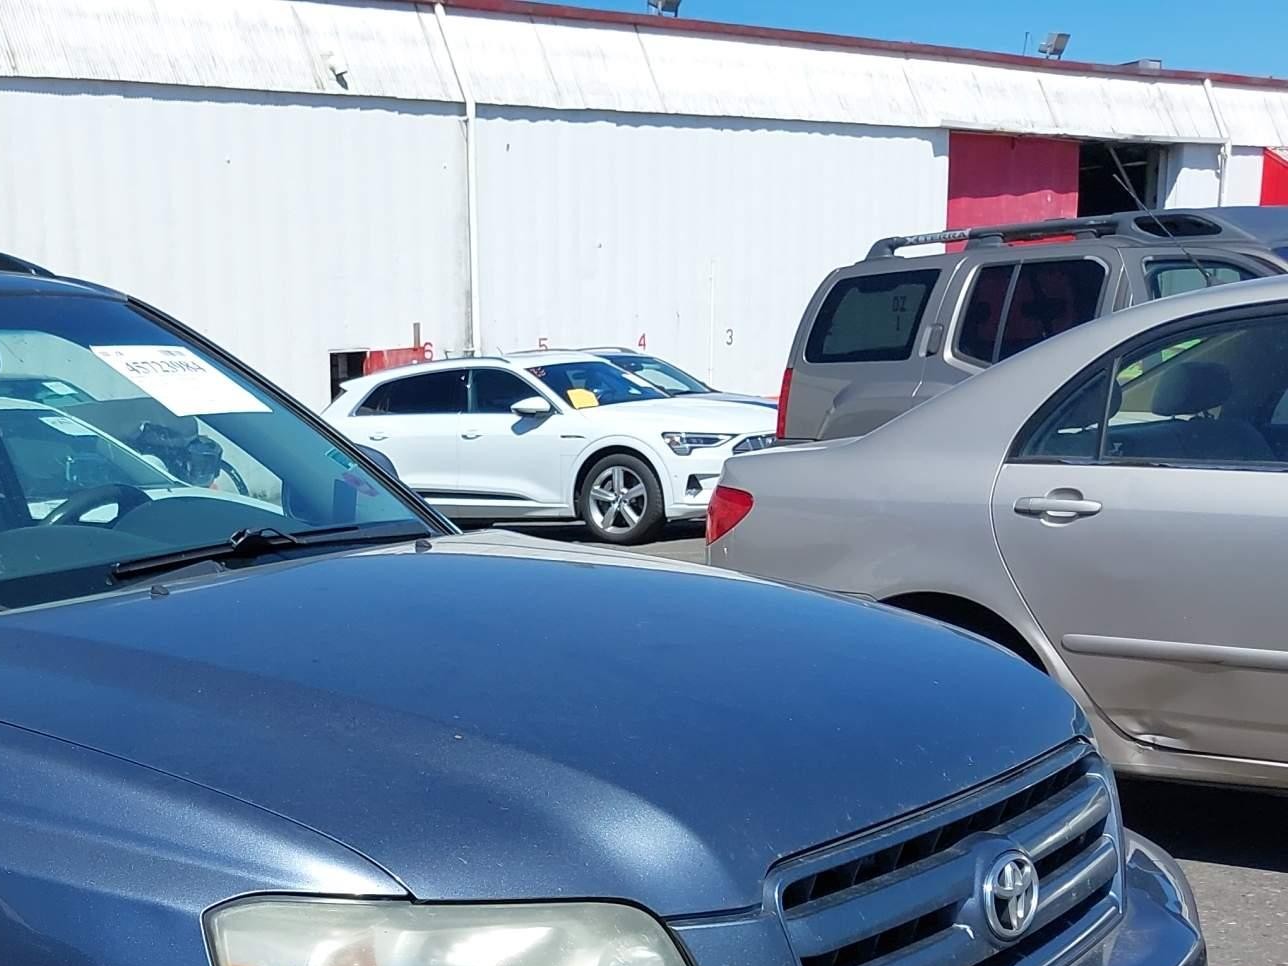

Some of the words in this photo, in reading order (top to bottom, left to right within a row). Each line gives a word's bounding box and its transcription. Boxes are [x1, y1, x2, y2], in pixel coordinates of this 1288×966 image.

[538, 337, 548, 351] 5
[638, 333, 647, 350] 4
[726, 329, 734, 345] 3
[424, 342, 433, 360] 6
